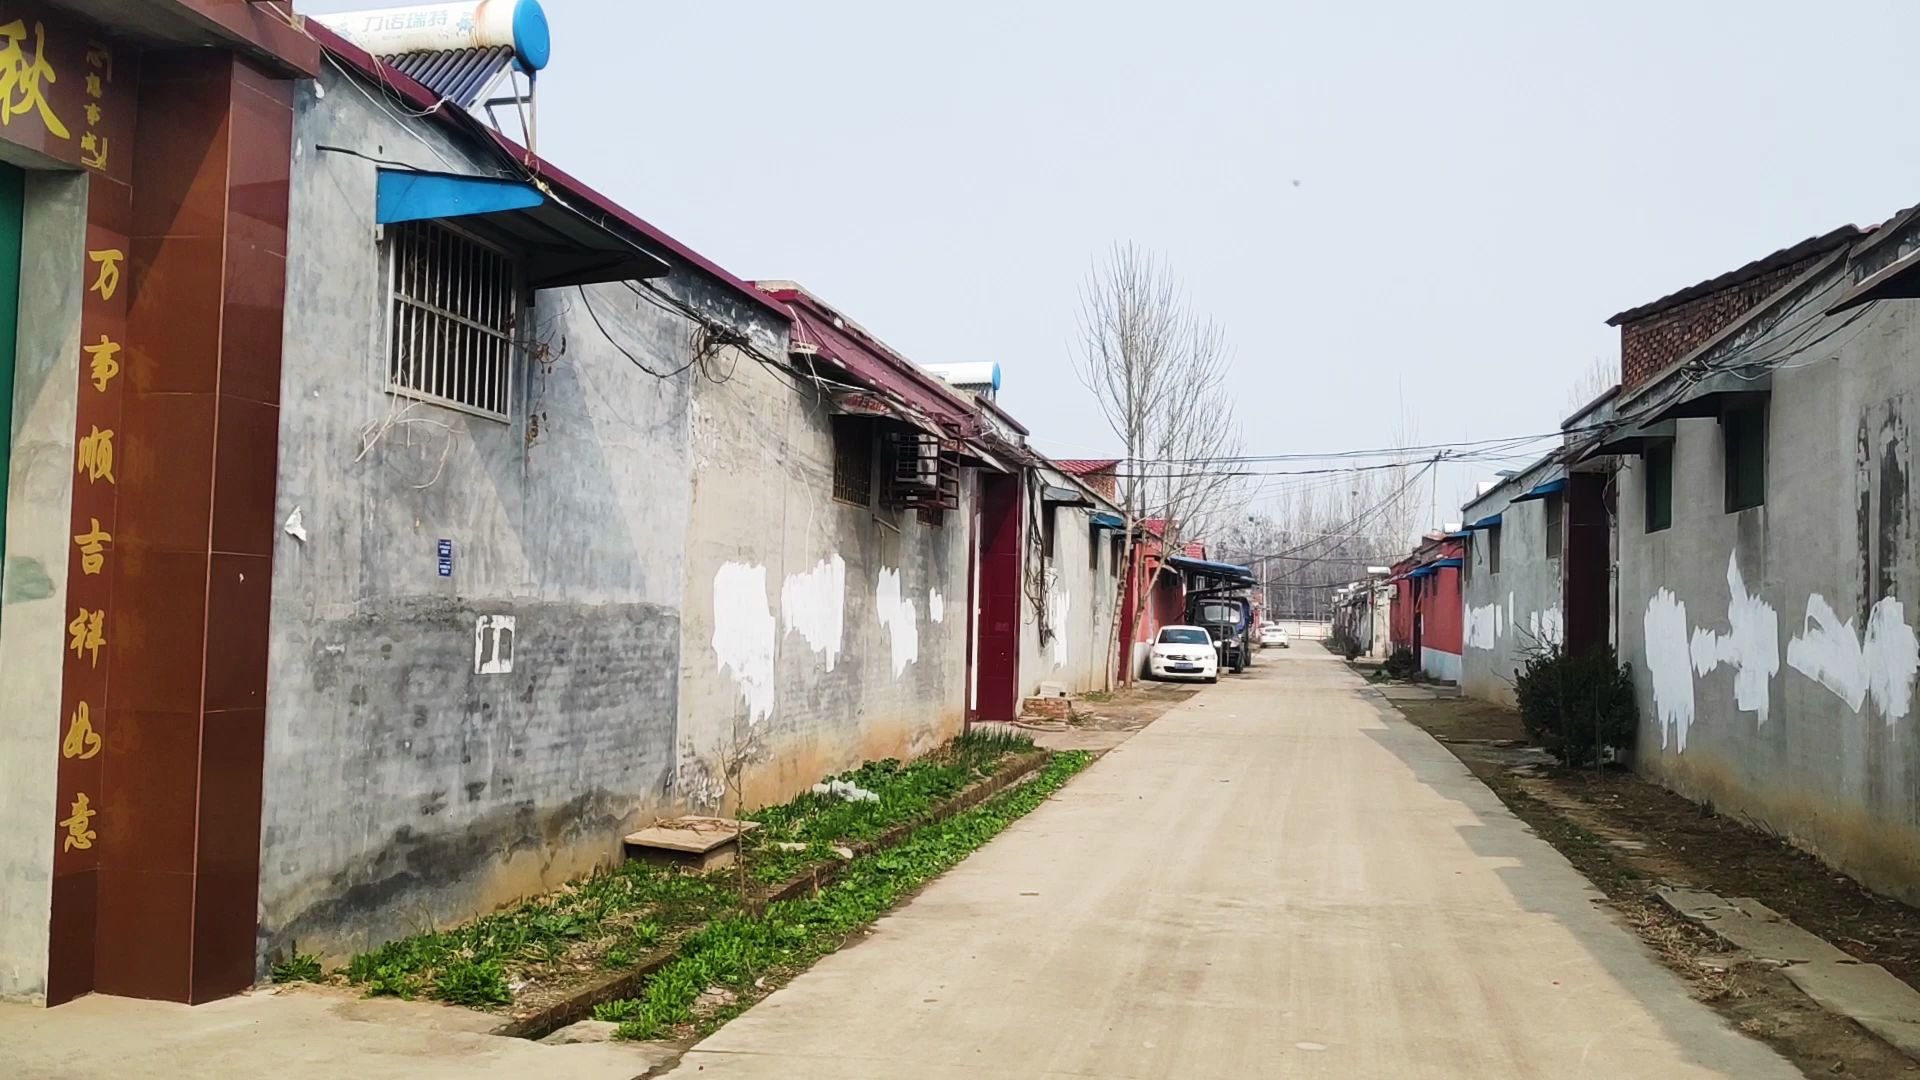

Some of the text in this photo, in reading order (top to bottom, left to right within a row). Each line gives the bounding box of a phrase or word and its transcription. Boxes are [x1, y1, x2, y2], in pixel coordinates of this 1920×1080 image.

[0, 18, 71, 140] 秋
[361, 9, 448, 33] 力诺瑞特
[59, 248, 124, 853] 万事顺吉祥如意
